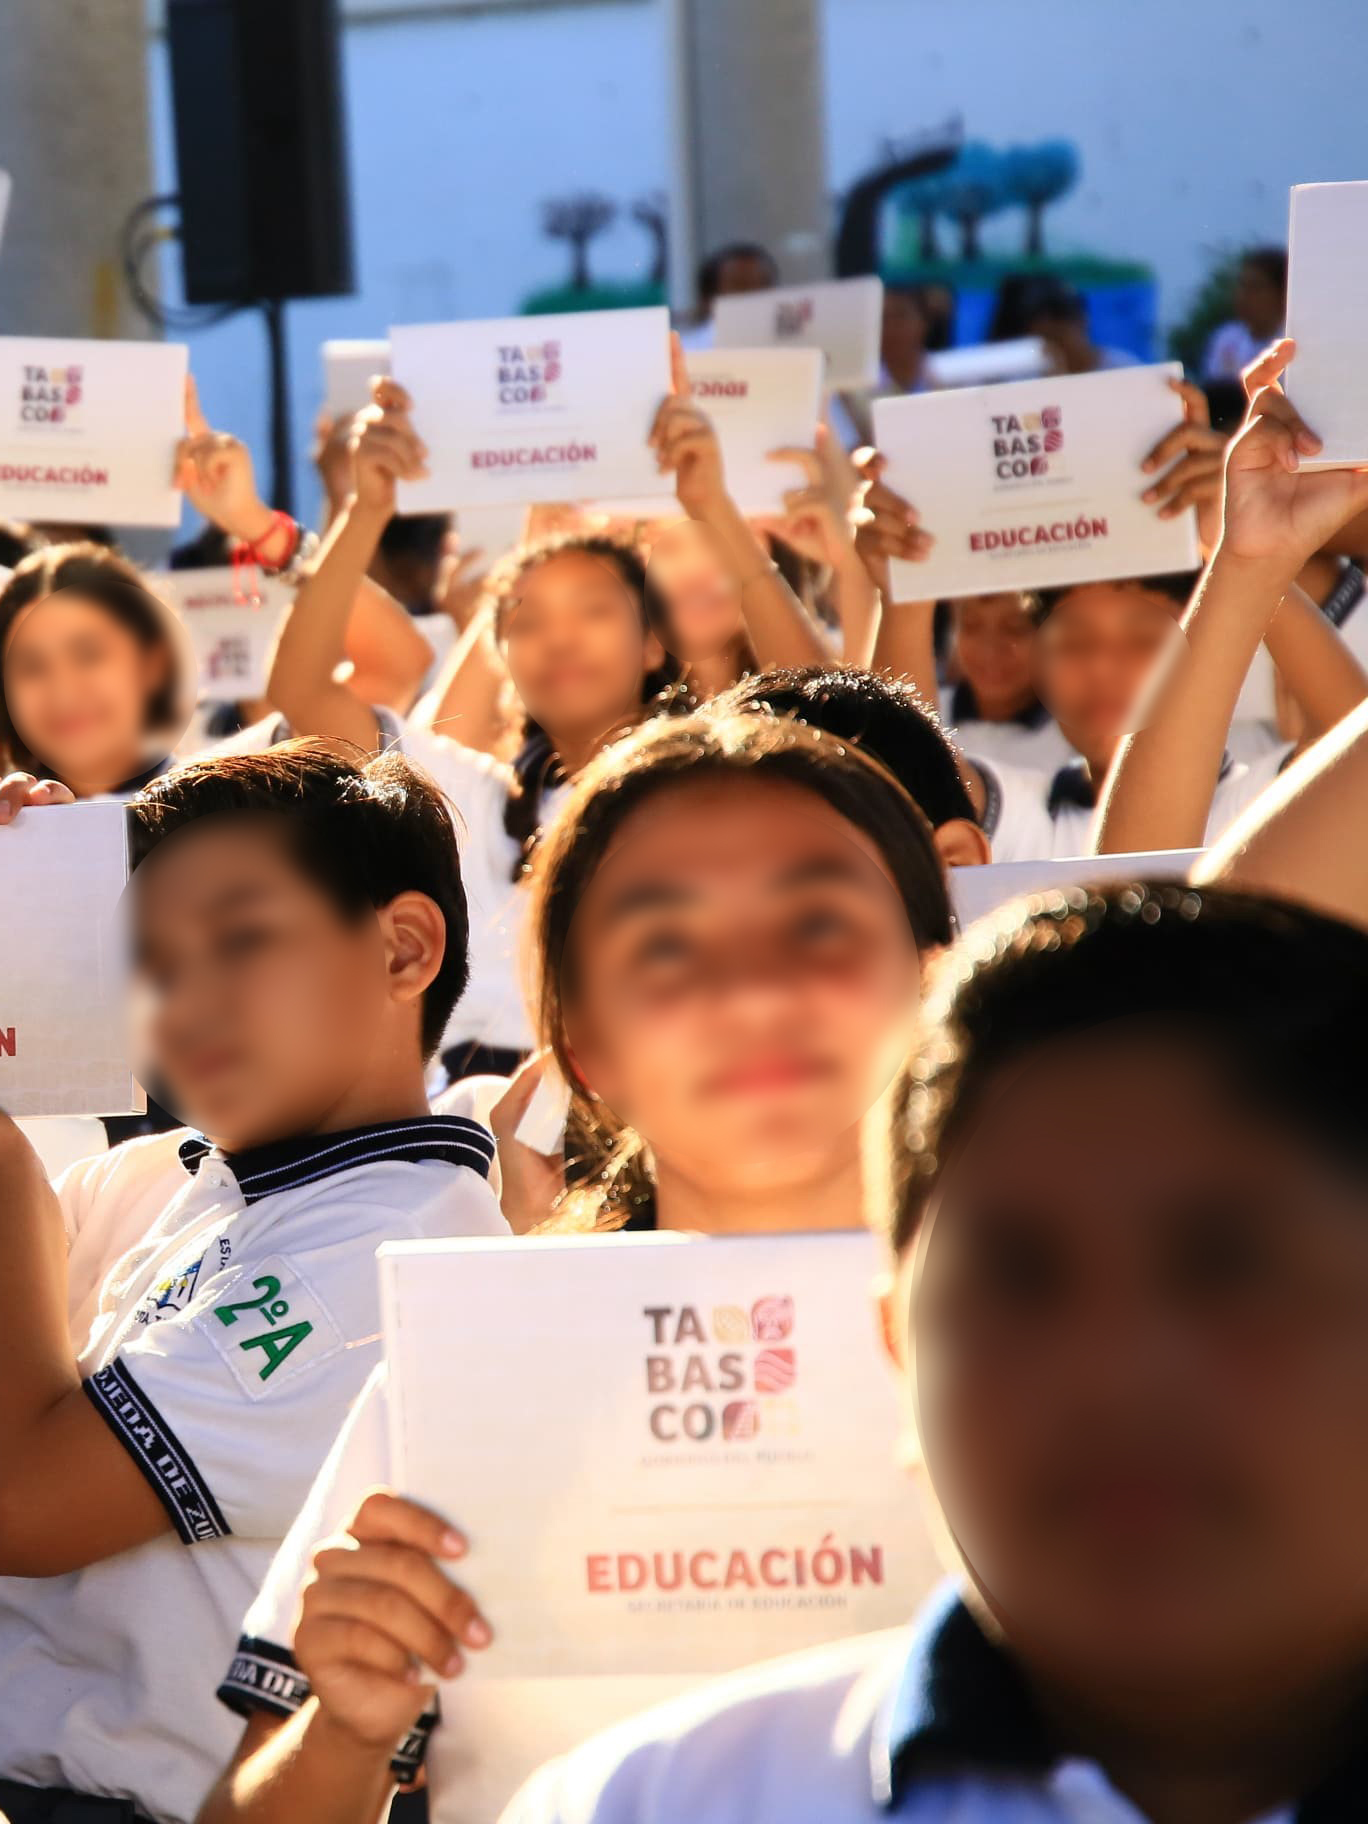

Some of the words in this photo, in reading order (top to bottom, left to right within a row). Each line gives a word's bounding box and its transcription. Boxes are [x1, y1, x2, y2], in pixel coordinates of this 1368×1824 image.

[991, 414, 1021, 434] TA
[471, 437, 597, 469] EDUCACIÓN
[993, 434, 1041, 457] BAS
[996, 459, 1028, 479] CO
[969, 513, 1107, 552] EDUCACIÓN
[643, 1306, 707, 1346] TA
[646, 1353, 746, 1395] BAS
[650, 1403, 715, 1442] CO
[156, 1454, 192, 1498] DE
[586, 1531, 884, 1593] EDUCACIÓN
